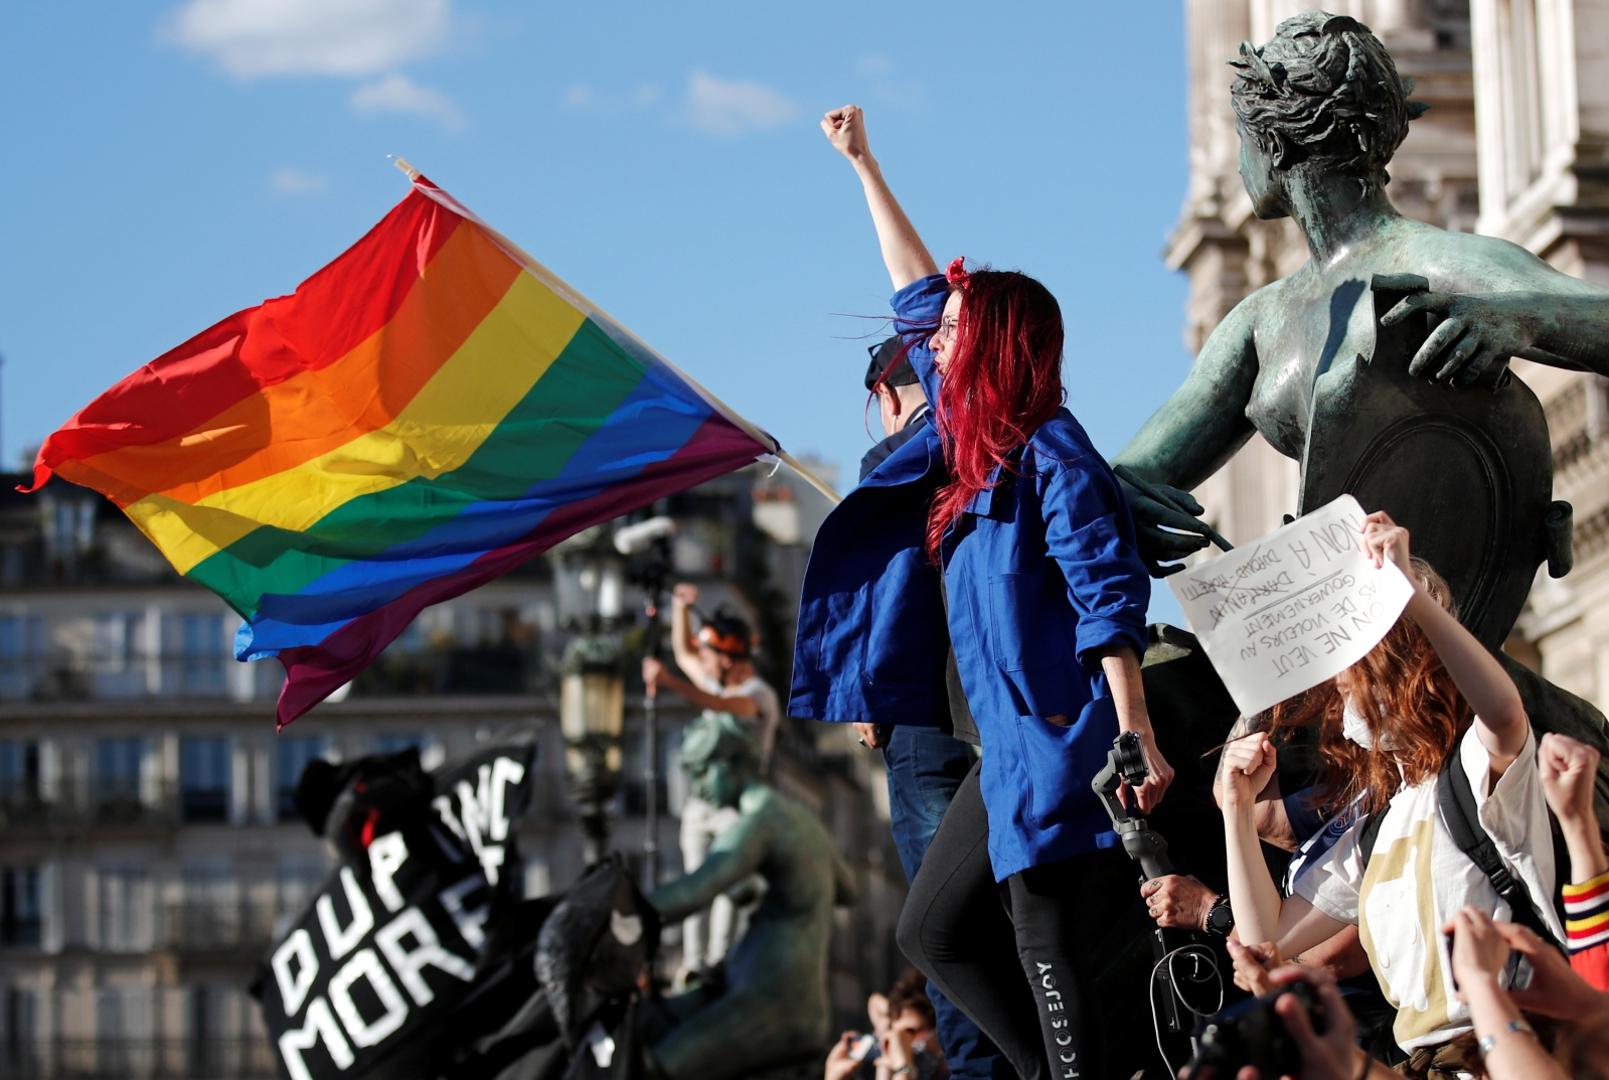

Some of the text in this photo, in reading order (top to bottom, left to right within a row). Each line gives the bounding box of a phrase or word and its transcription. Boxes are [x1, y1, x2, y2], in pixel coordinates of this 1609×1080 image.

[1309, 513, 1362, 562] NON
[1247, 574, 1356, 638] GOUVERNEMENT
[1331, 596, 1357, 619] DE
[1262, 612, 1327, 649] VIOLEURS
[1271, 602, 1384, 678] ON NE VEUT
[1240, 645, 1262, 662] AU
